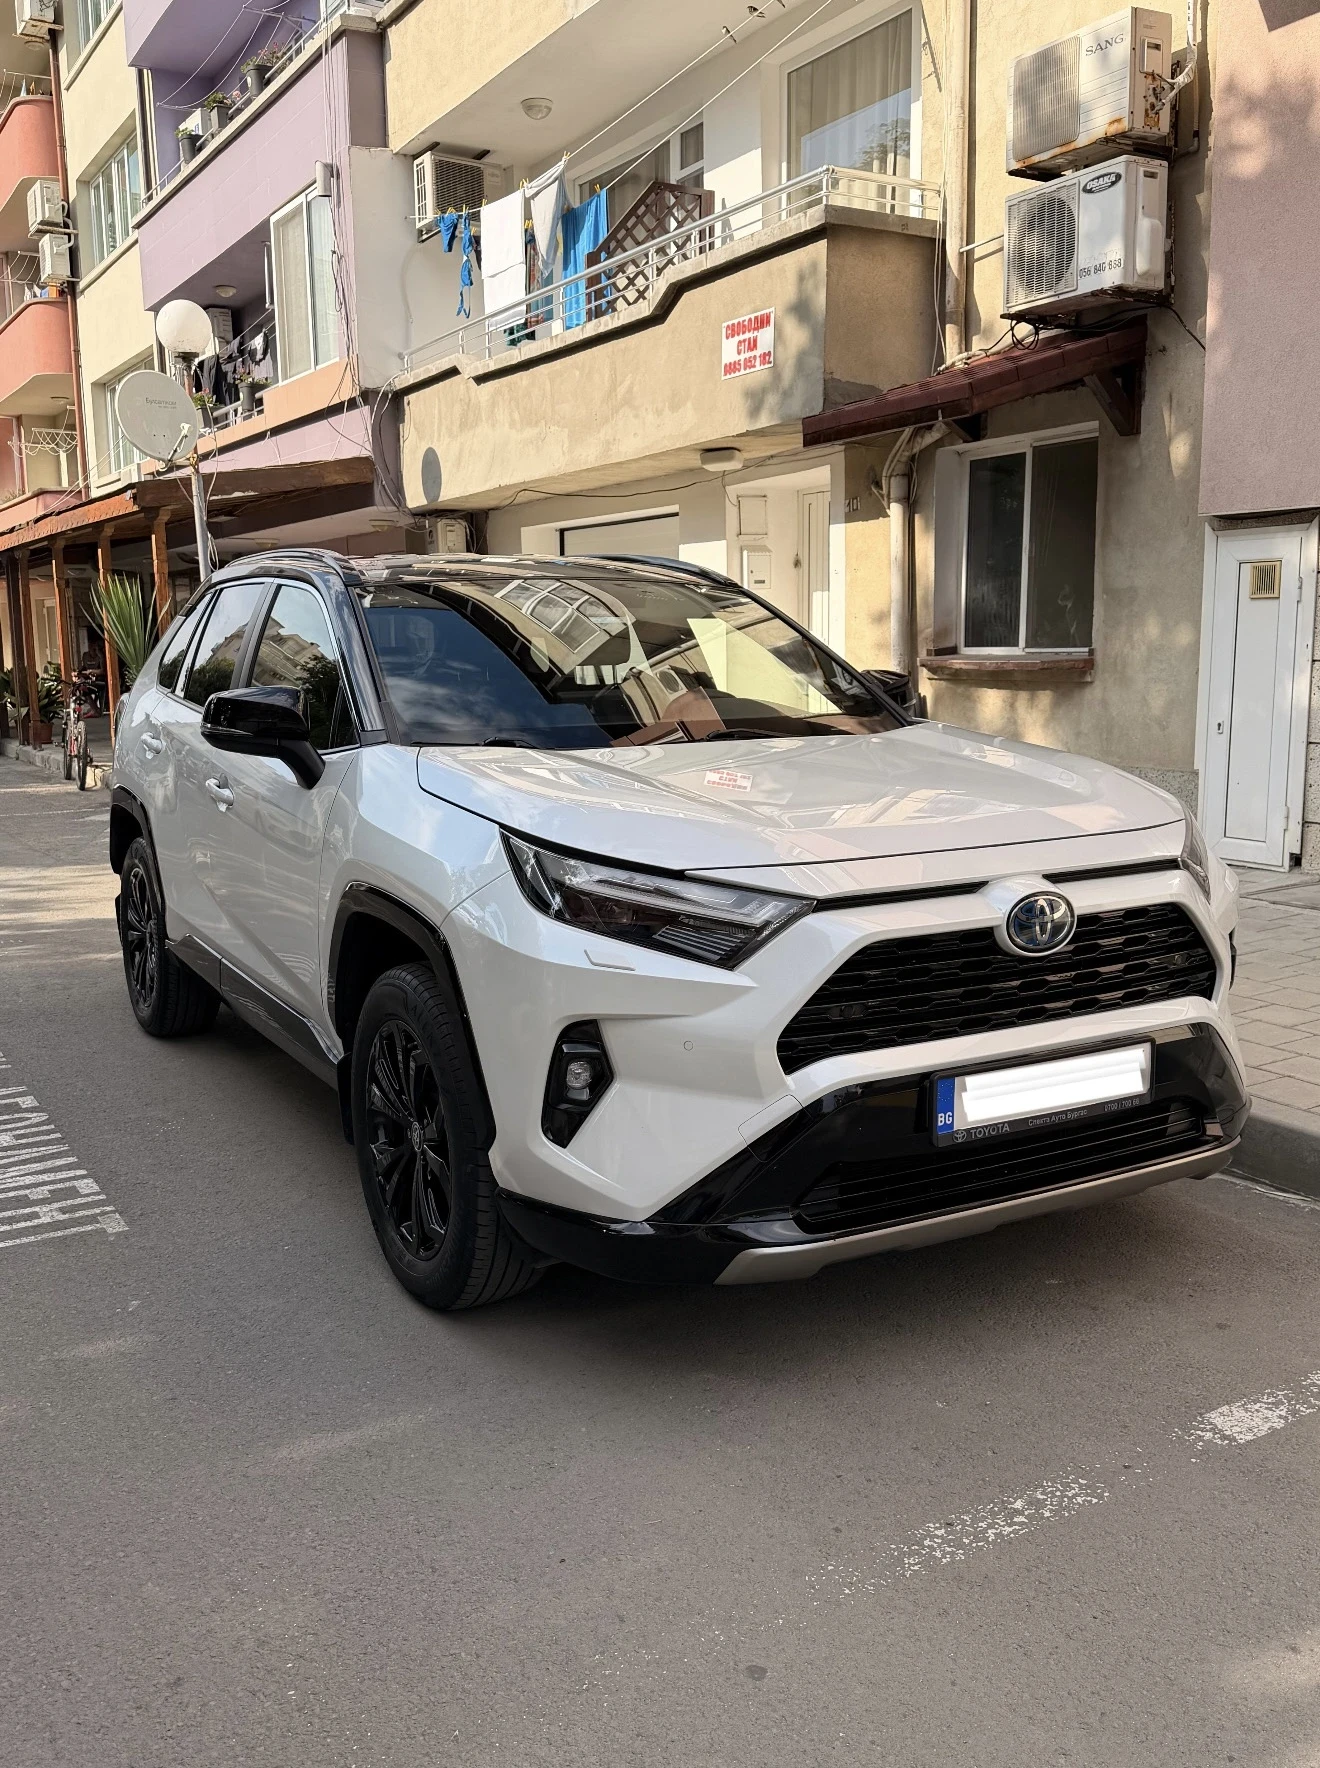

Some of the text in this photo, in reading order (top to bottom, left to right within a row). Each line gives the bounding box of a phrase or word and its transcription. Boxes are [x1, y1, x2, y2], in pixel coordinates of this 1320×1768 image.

[1085, 33, 1124, 56] SANG
[1086, 174, 1116, 190] OSAKA
[726, 312, 771, 340] СВОБОДНИ
[938, 1112, 952, 1126] BG
[970, 1123, 1010, 1139] TOYOTA
